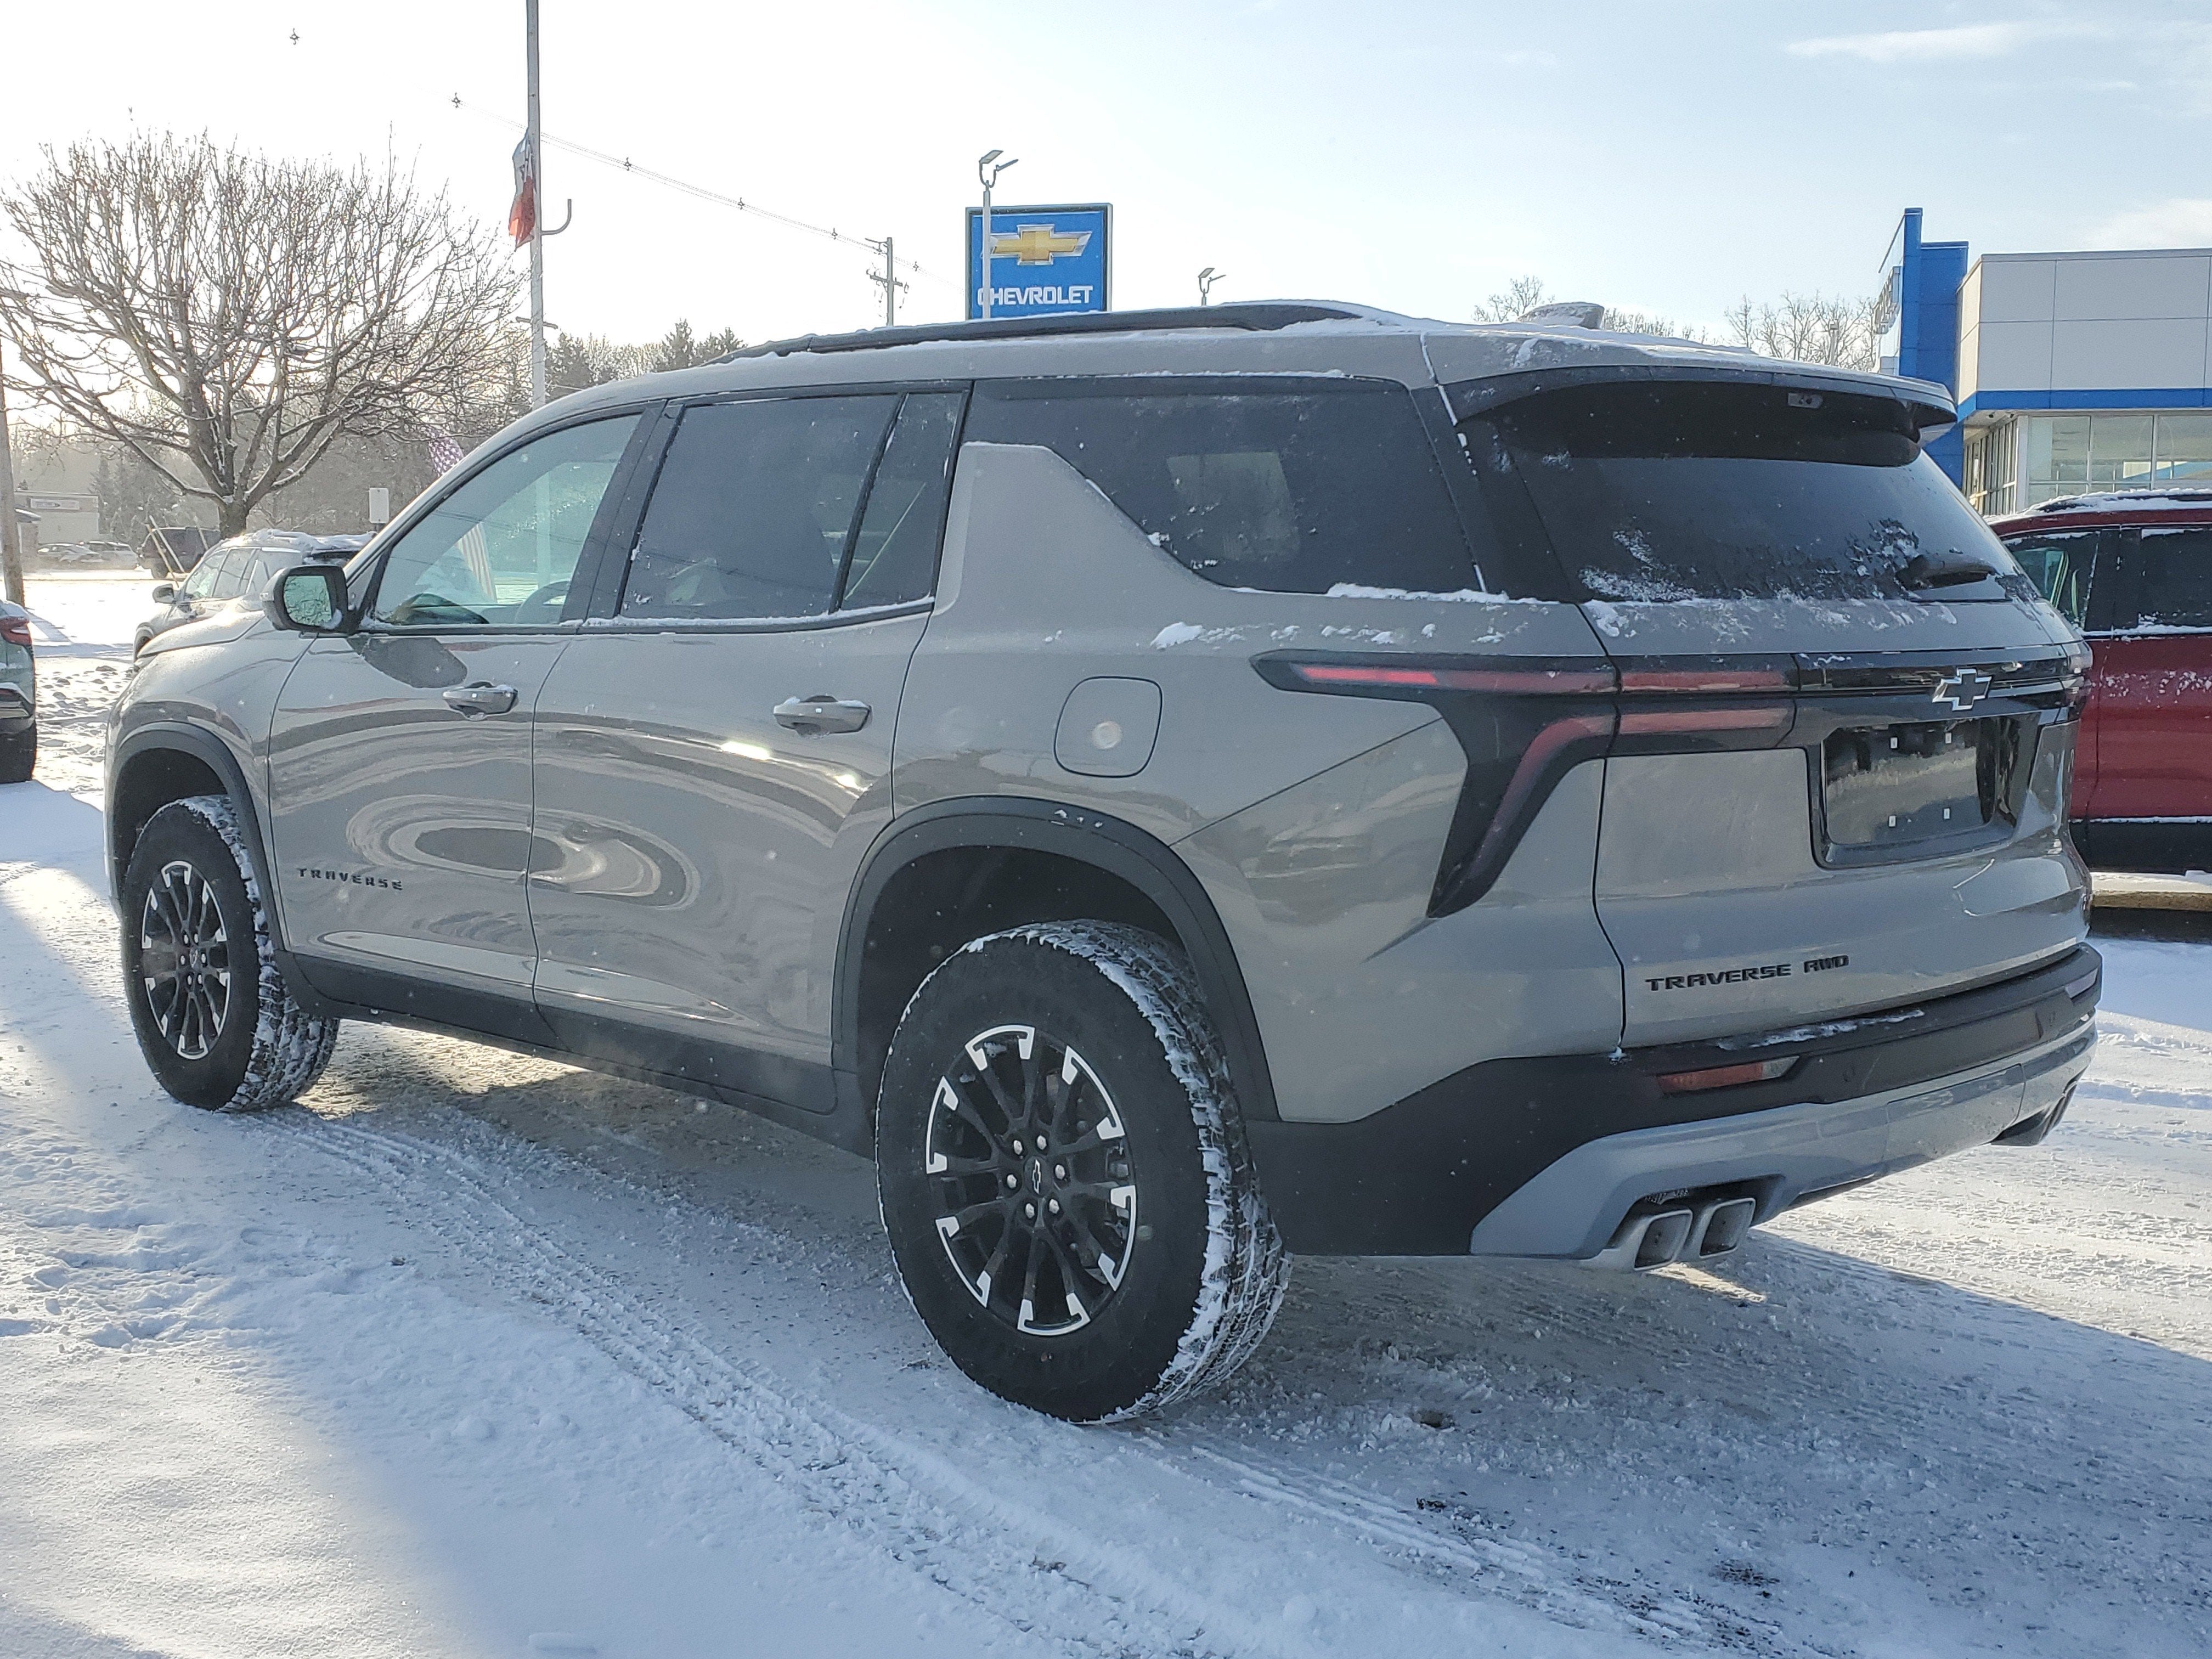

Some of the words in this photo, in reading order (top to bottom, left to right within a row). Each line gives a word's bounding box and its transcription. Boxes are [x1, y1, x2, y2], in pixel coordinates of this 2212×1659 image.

[297, 868, 403, 890] TRAVERSE
[1645, 964, 1791, 991] TRAVERSE
[1804, 955, 1849, 973] AWD
